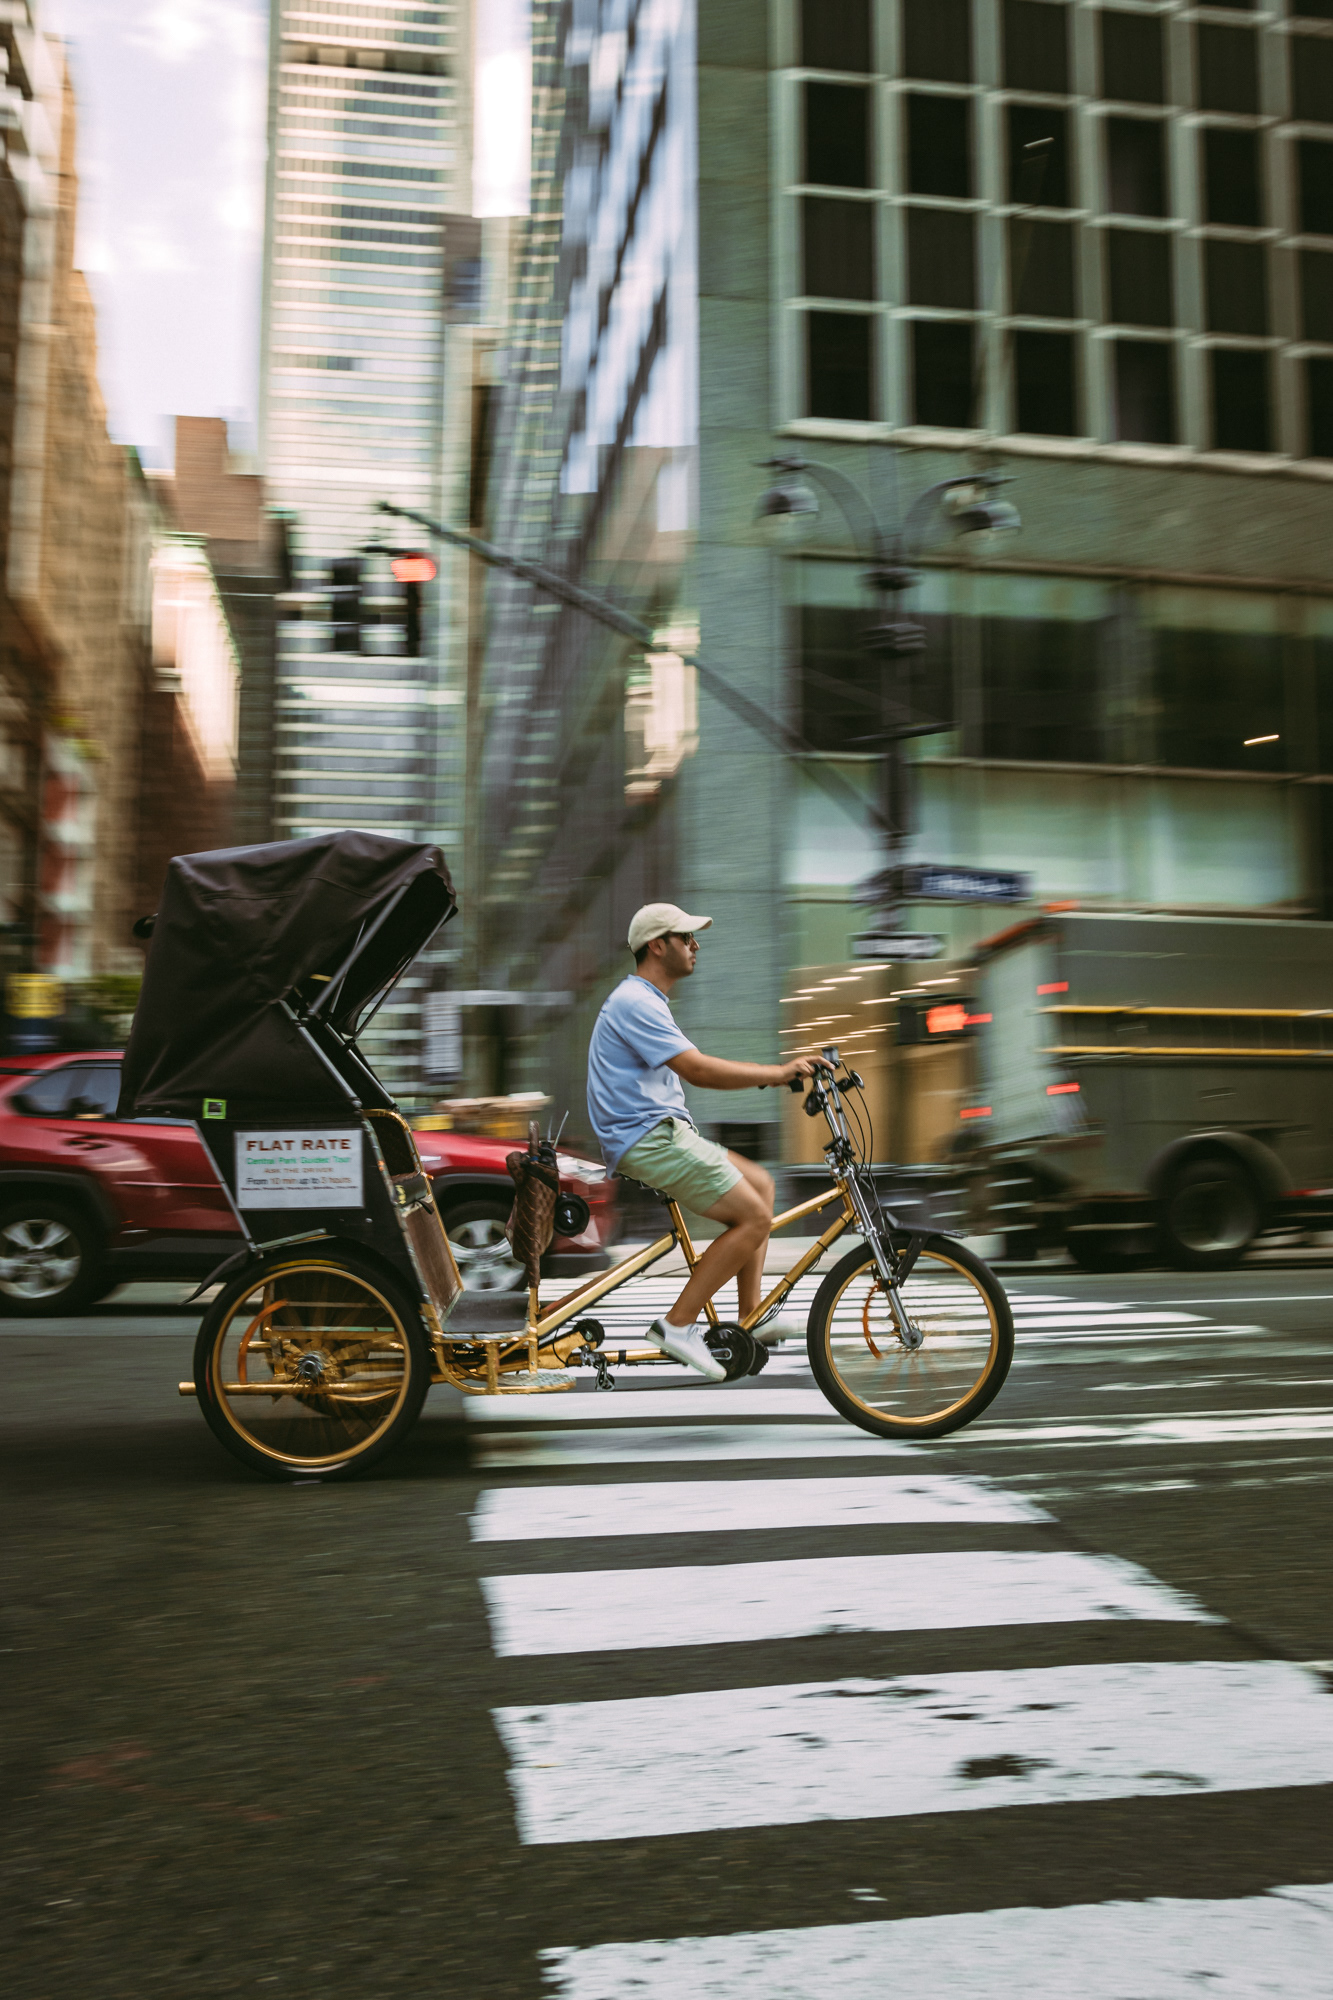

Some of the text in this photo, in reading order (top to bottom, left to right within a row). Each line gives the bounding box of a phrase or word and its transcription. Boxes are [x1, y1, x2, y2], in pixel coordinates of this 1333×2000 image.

[246, 1139, 351, 1151] FLAT RATE
[246, 1155, 351, 1165] Central Park Guided Tour
[246, 1177, 268, 1185] From
